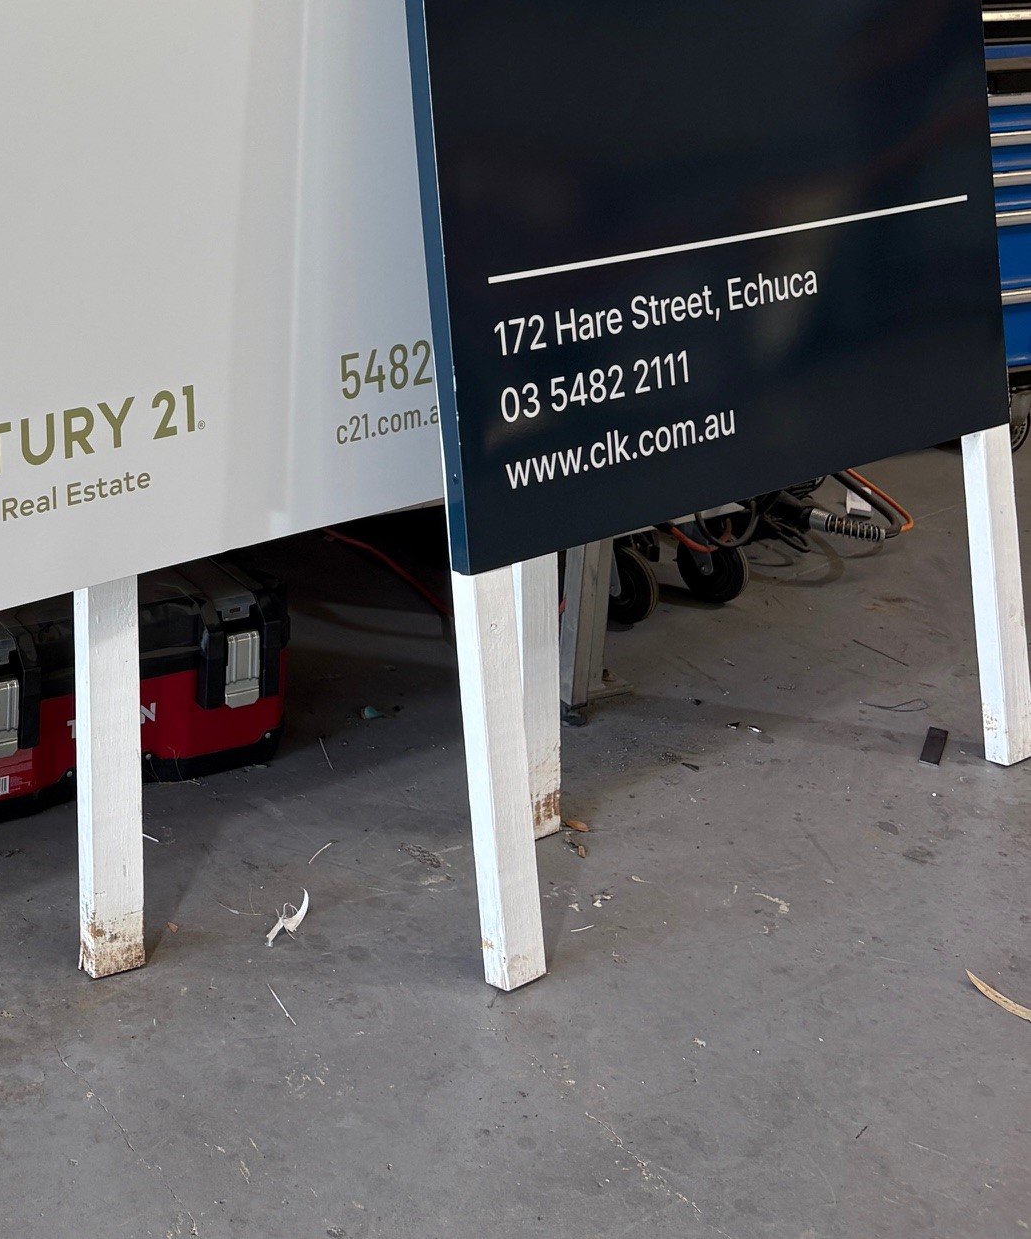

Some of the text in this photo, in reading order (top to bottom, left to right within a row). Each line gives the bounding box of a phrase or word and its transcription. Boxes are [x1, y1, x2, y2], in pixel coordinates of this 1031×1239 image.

[493, 270, 818, 356] 172 Hare Street, Echuca
[340, 339, 433, 400] 5482
[500, 349, 690, 423] 03 5482 2111
[336, 405, 440, 445] c21.com.a
[505, 409, 737, 490] www.clk.com.au
[1, 485, 57, 522] Real
[66, 470, 152, 507] Estate
